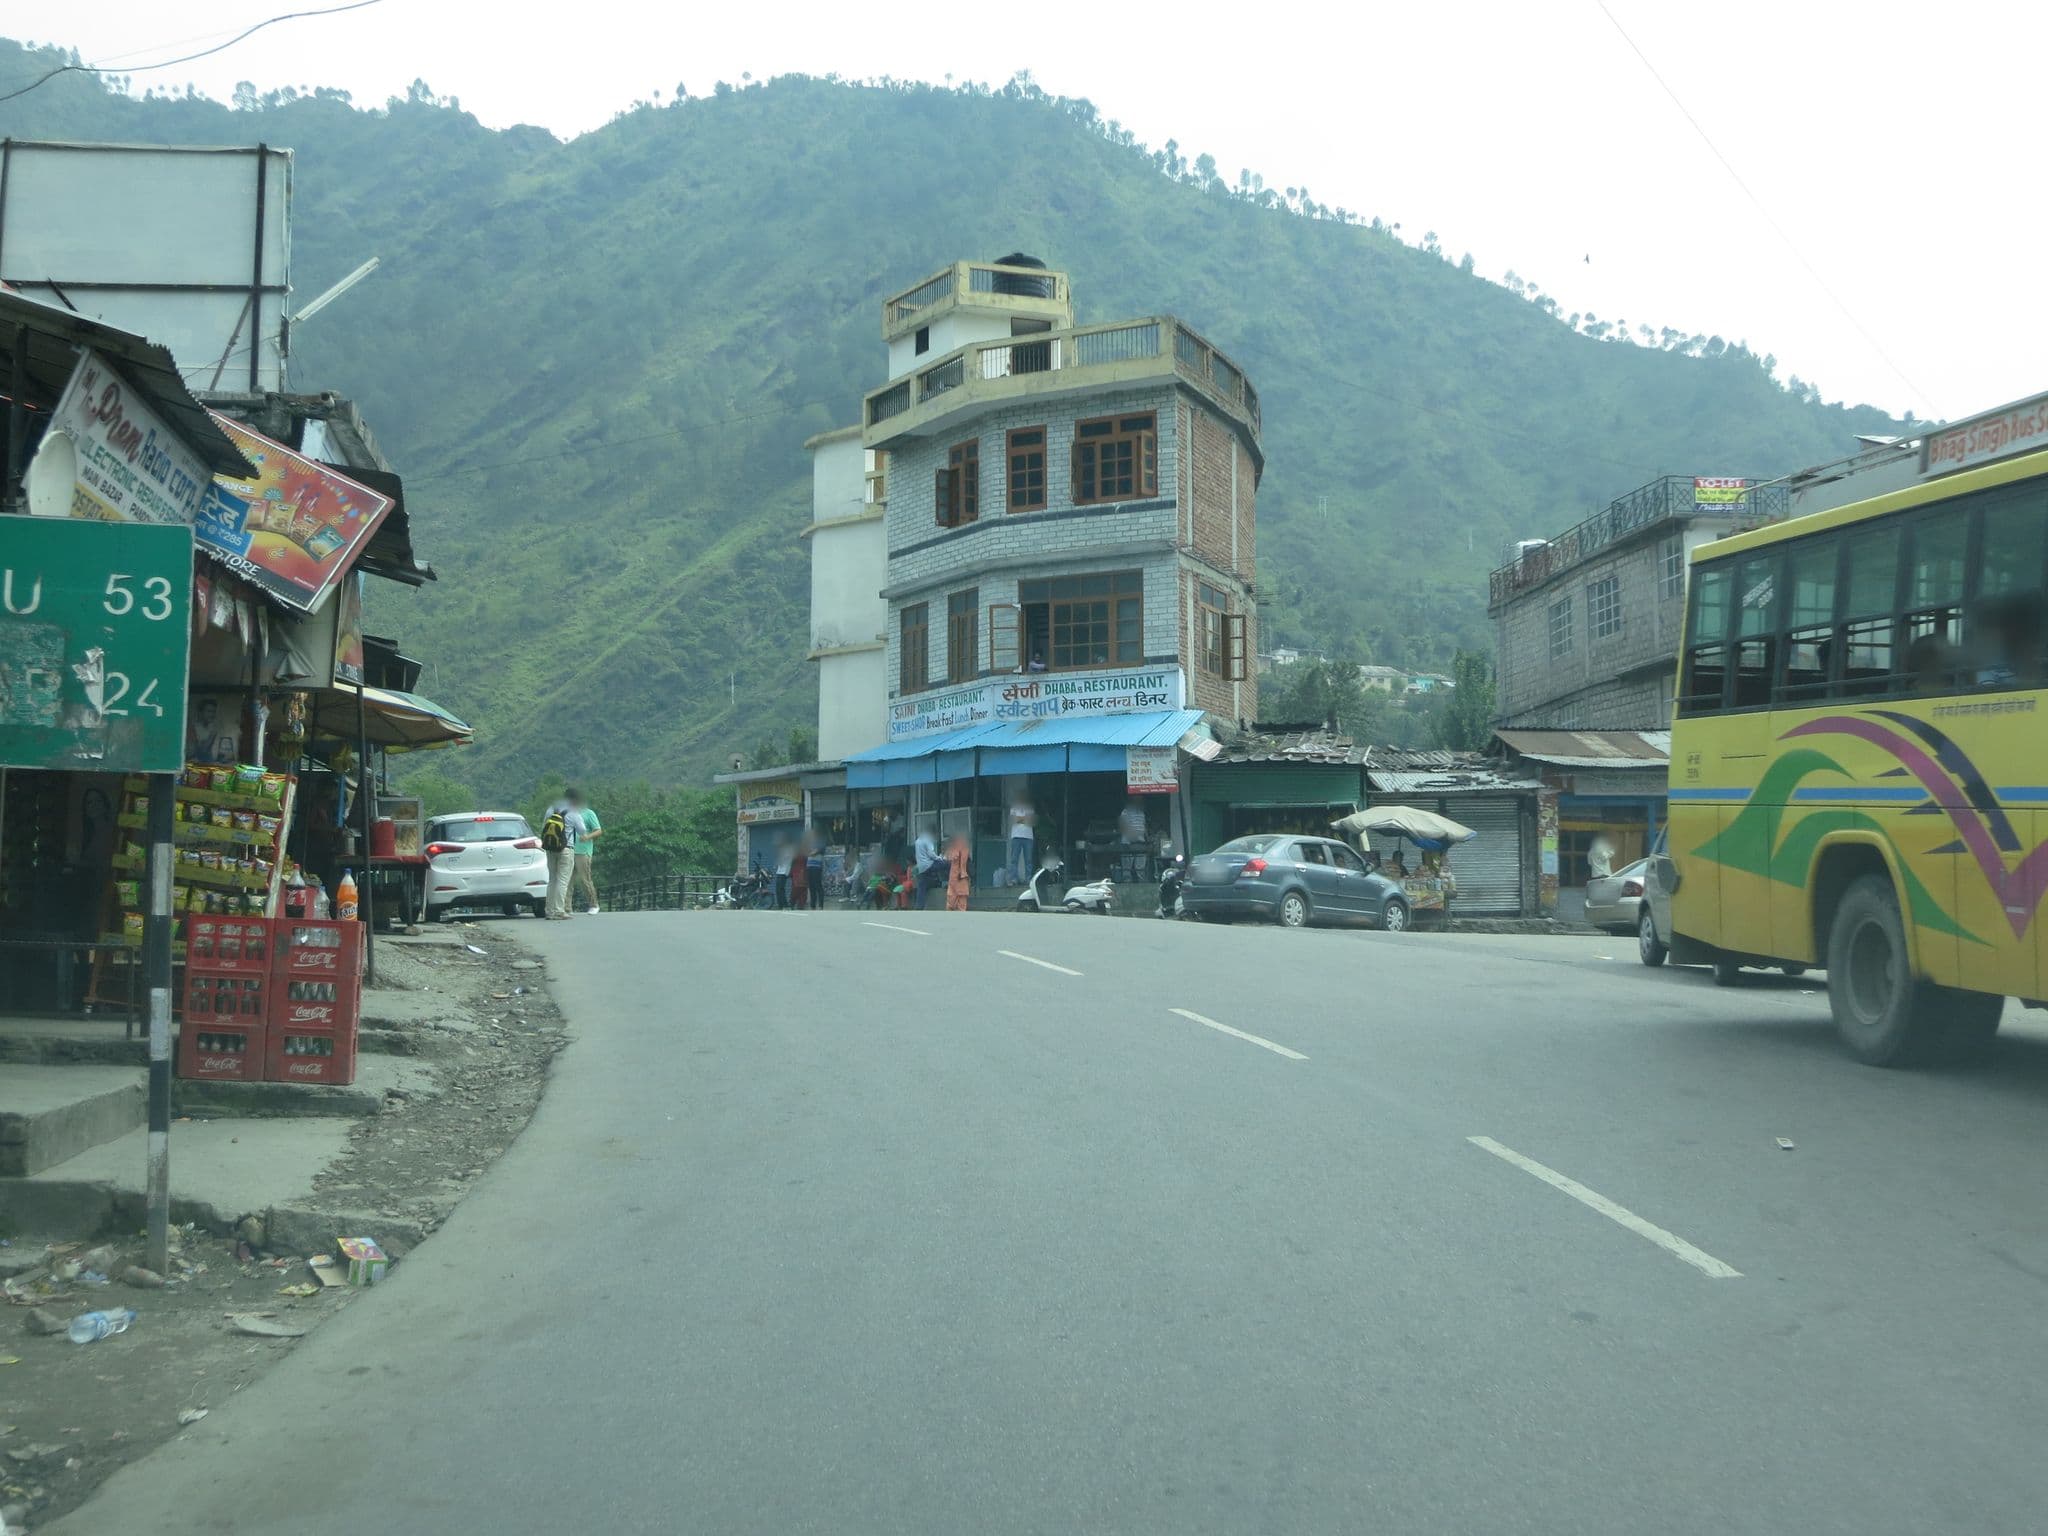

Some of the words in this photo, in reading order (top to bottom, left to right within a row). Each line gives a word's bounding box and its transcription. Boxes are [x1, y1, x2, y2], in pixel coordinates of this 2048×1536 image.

[2010, 413, 2036, 441] Bus
[99, 480, 125, 503] BAZAR
[1698, 479, 1743, 488] TO-LET
[103, 574, 173, 621] 53
[101, 671, 163, 717] 24
[1045, 681, 1077, 695] DHABA
[1134, 691, 1168, 707] डिनर
[894, 702, 916, 719] SAINI
